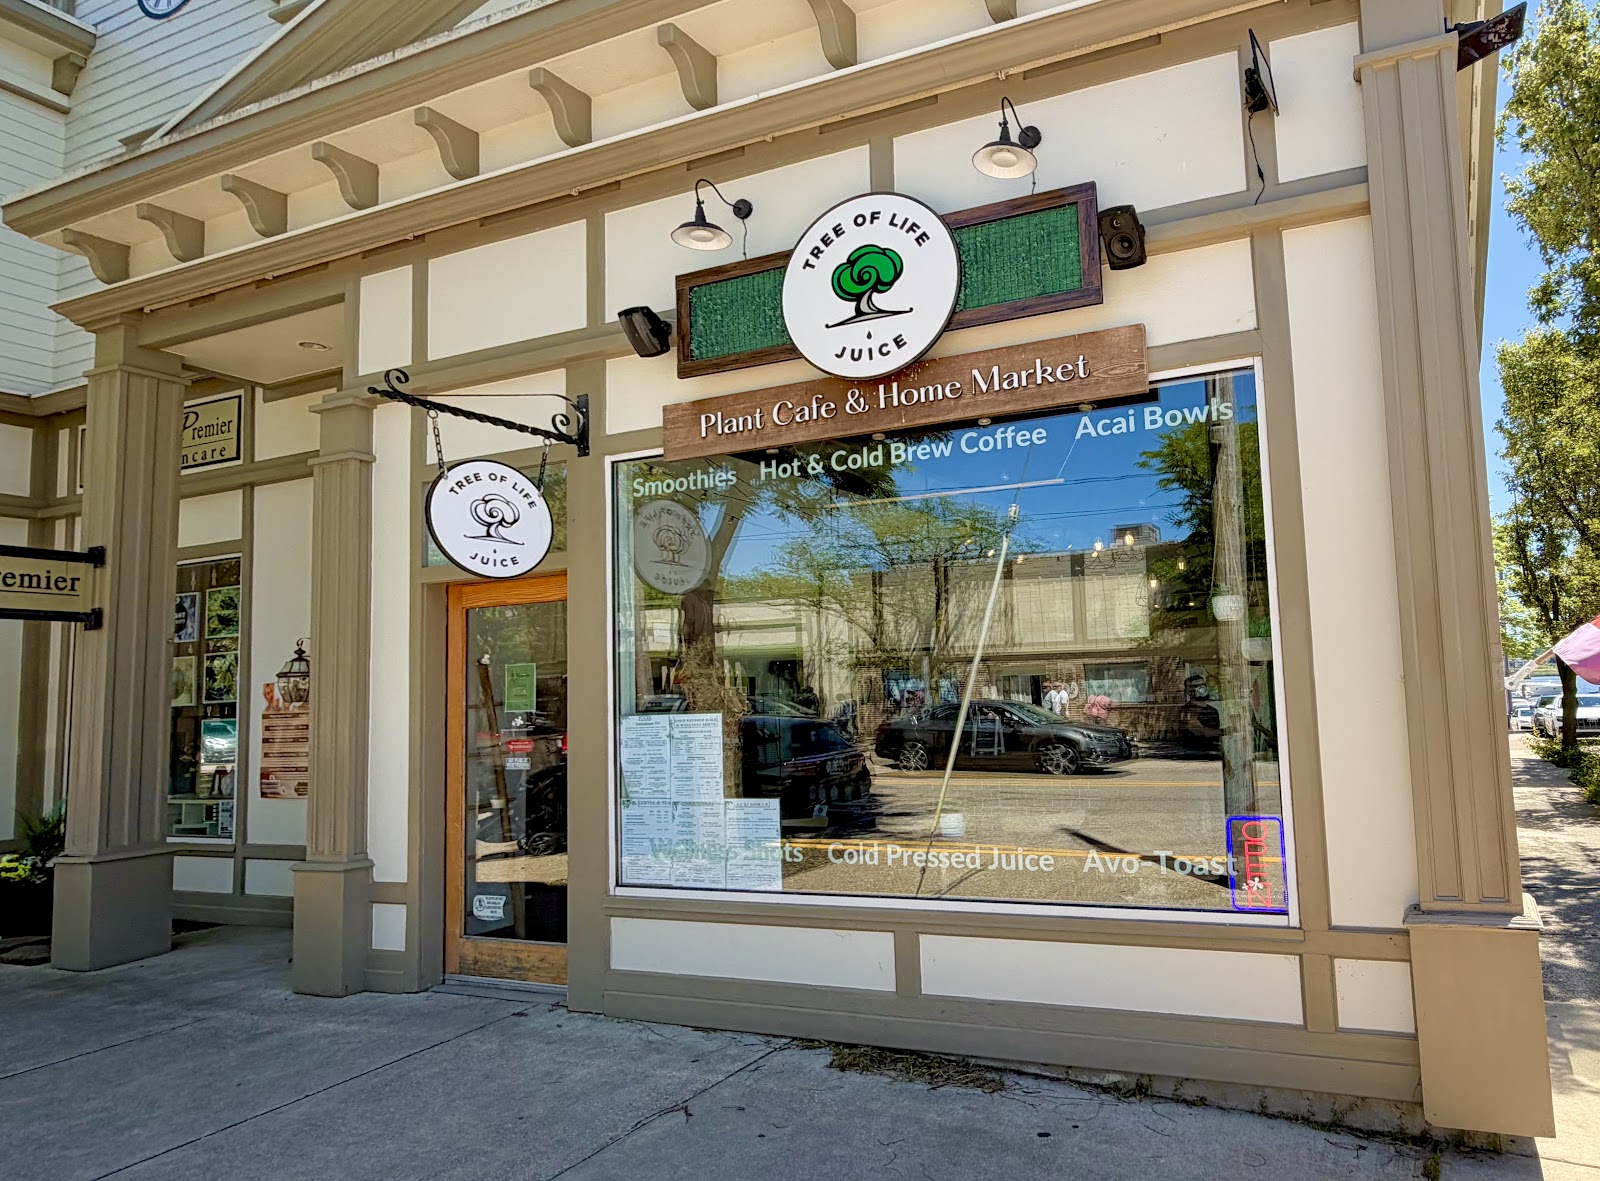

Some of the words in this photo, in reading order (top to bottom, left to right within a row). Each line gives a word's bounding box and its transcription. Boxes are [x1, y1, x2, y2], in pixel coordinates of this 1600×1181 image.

[802, 223, 846, 271] TREE
[853, 211, 882, 227] OF
[888, 213, 931, 247] LIFE
[834, 333, 908, 362] JUICE
[700, 408, 765, 438] Plant
[772, 394, 837, 426] Cafe
[845, 388, 870, 415] &
[878, 380, 963, 409] Home
[971, 354, 1091, 395] Market
[183, 411, 233, 440] Premier
[1075, 408, 1135, 439] Acai
[1143, 397, 1234, 431] Bowls
[760, 460, 801, 481] Hot
[806, 453, 824, 475] &
[830, 445, 883, 471] Cold
[890, 440, 953, 464] Brew
[960, 425, 1047, 454] Coffee
[448, 472, 483, 496] TREE
[488, 472, 508, 484] OF
[512, 482, 537, 510] LIFE
[633, 468, 737, 498] Smoothies
[469, 552, 520, 567] JUICE
[0, 570, 81, 591] emier
[827, 842, 879, 866] Cold
[886, 843, 982, 869] Pressed
[987, 847, 1055, 872] Juice
[1082, 849, 1238, 875] Avo-Toast
[1241, 820, 1273, 908] OPEN
